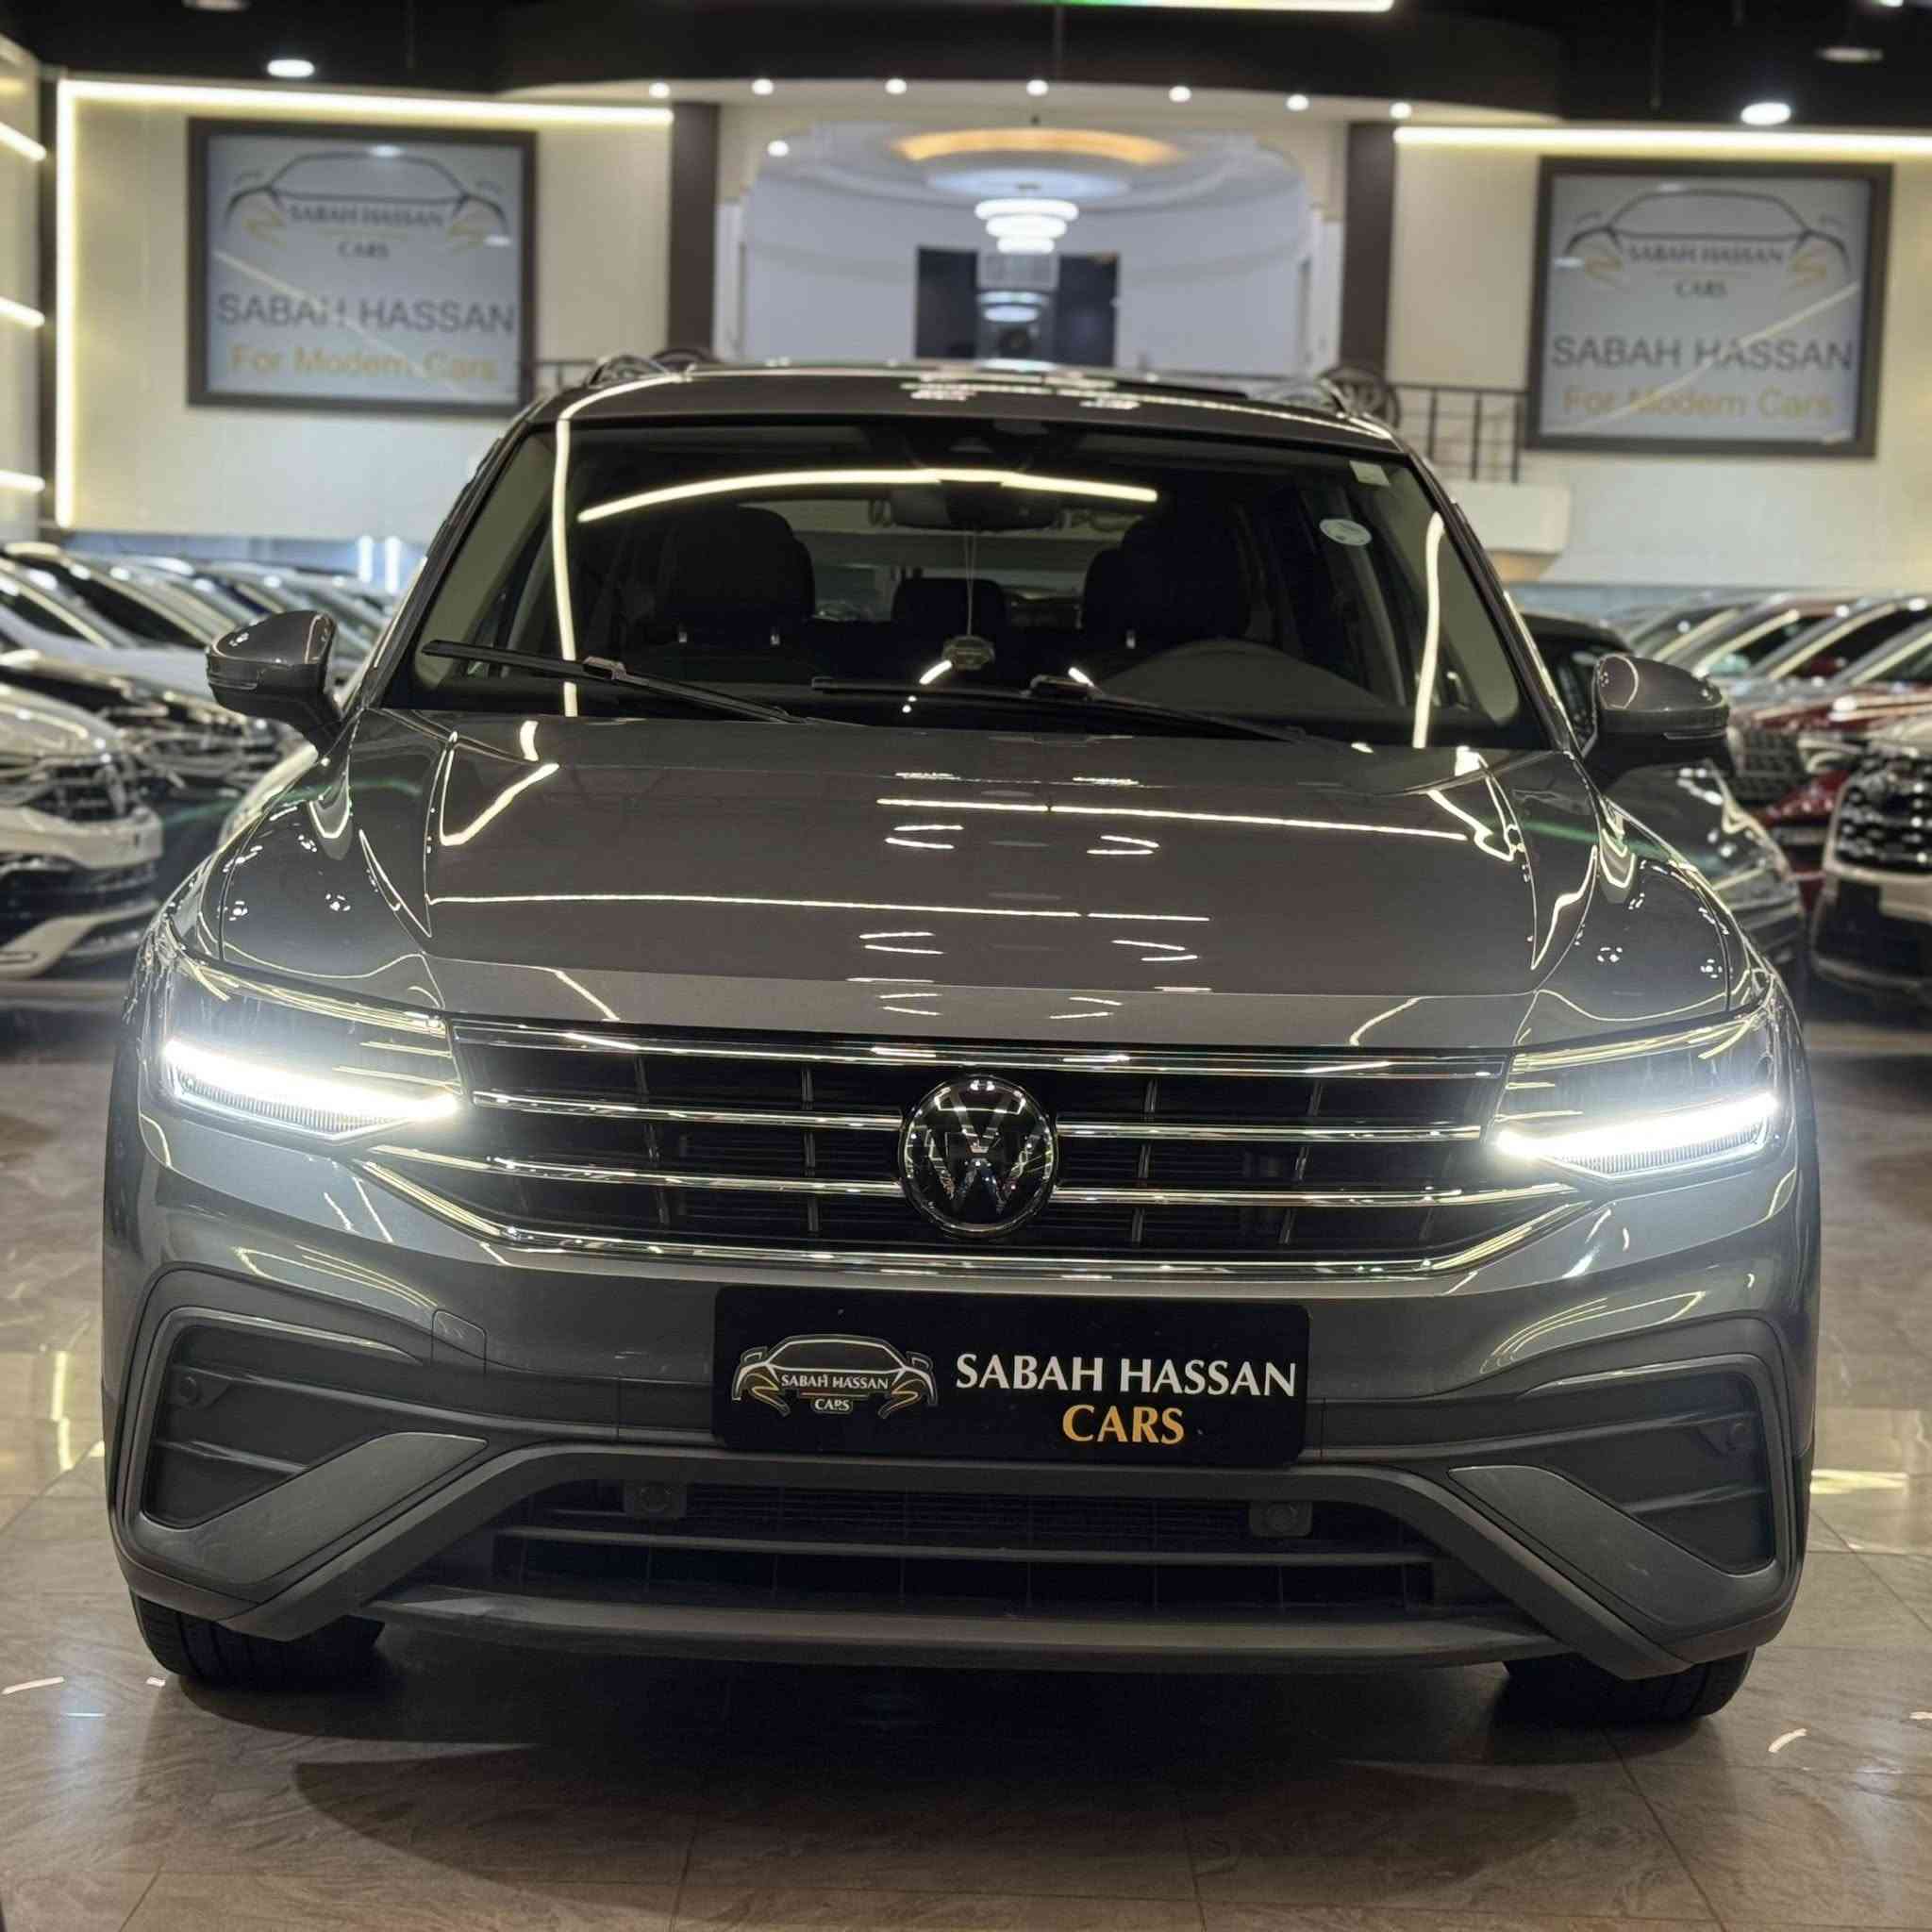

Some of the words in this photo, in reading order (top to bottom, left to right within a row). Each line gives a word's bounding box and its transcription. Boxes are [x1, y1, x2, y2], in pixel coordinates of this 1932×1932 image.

[217, 292, 346, 327] SABAH
[358, 298, 515, 333] HASSAN
[229, 344, 280, 374] For
[423, 349, 498, 381] Cars
[1552, 335, 1682, 368] SABAH
[1694, 336, 1853, 371] HASSAN
[1562, 386, 1615, 415] For
[1757, 387, 1834, 418] Cars
[780, 1373, 829, 1389] SABAH
[832, 1375, 890, 1391] HASSAN
[955, 1352, 1105, 1392] SABAH
[1120, 1357, 1297, 1398] HASSAN
[1061, 1403, 1185, 1446] CARS
